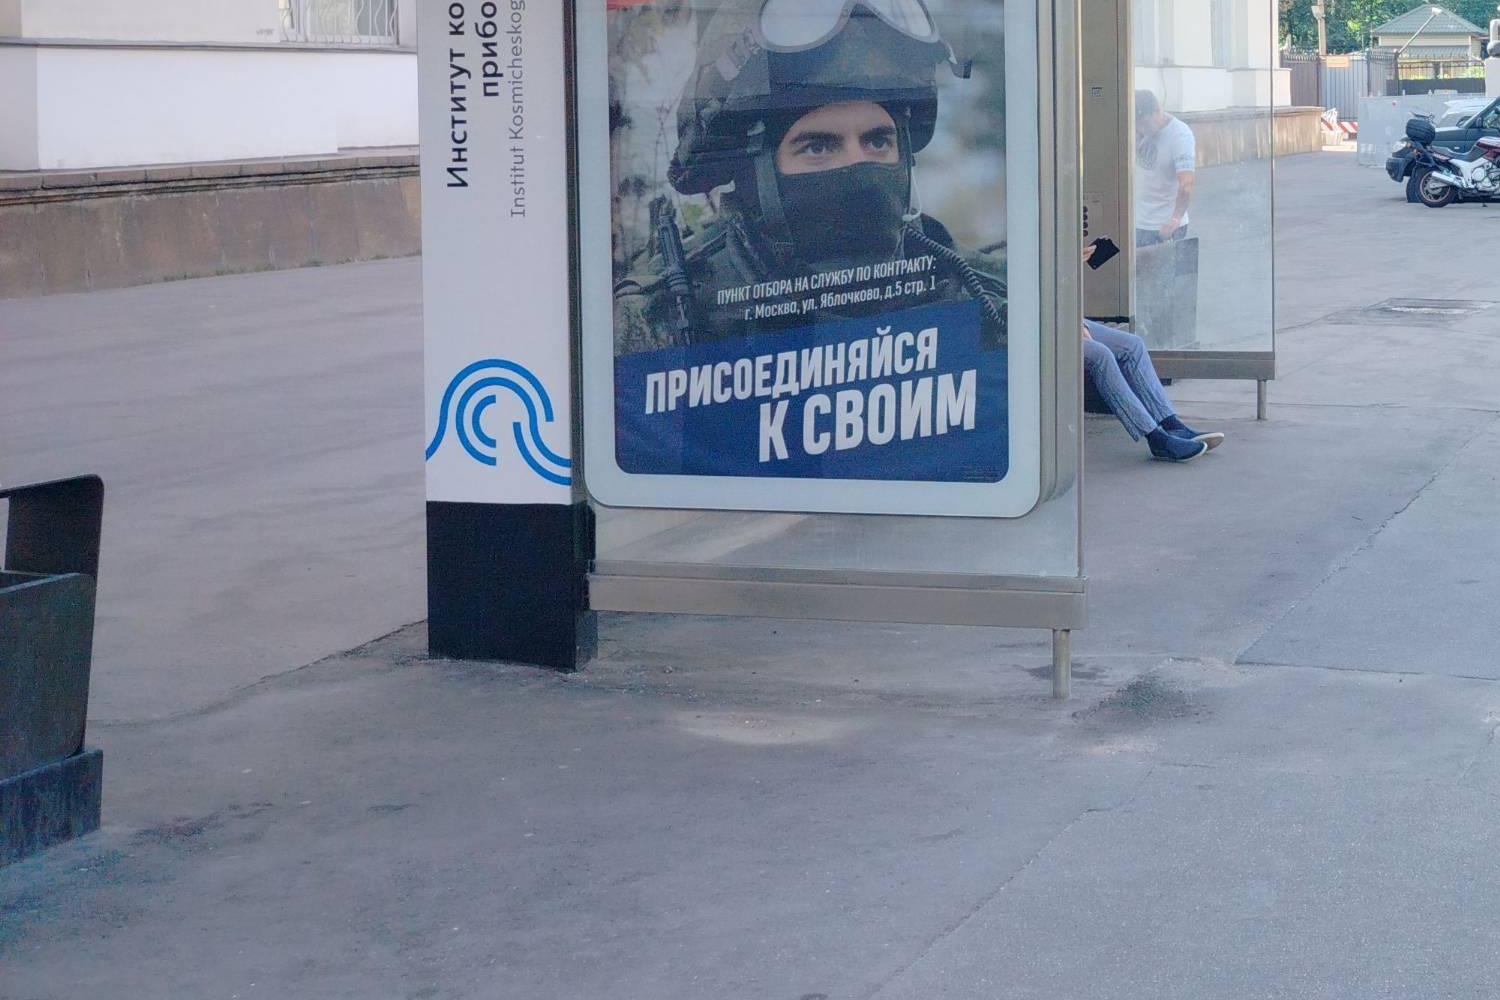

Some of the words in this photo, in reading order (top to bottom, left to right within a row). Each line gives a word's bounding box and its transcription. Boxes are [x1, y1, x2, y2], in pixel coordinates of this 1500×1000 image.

[447, 48, 471, 187] Институт
[509, 146, 525, 218] Institut
[717, 285, 752, 305] ПУНКТ
[753, 279, 793, 299] ОТБОРА
[794, 277, 809, 293] НА
[811, 267, 854, 290] СЛУЖБУ
[856, 265, 871, 282] ПО
[874, 254, 937, 280] КОНТРАКТУ:
[744, 309, 752, 321] г.
[755, 300, 800, 320] Москва,
[802, 297, 818, 315] ул.
[820, 289, 883, 309] Яблочкова,
[904, 279, 927, 297] стр.
[930, 275, 936, 291] 1
[645, 325, 938, 415] ПРИСОЕДИНЯЙСЯ
[758, 400, 790, 463] К
[803, 369, 977, 455] СВОИМ
